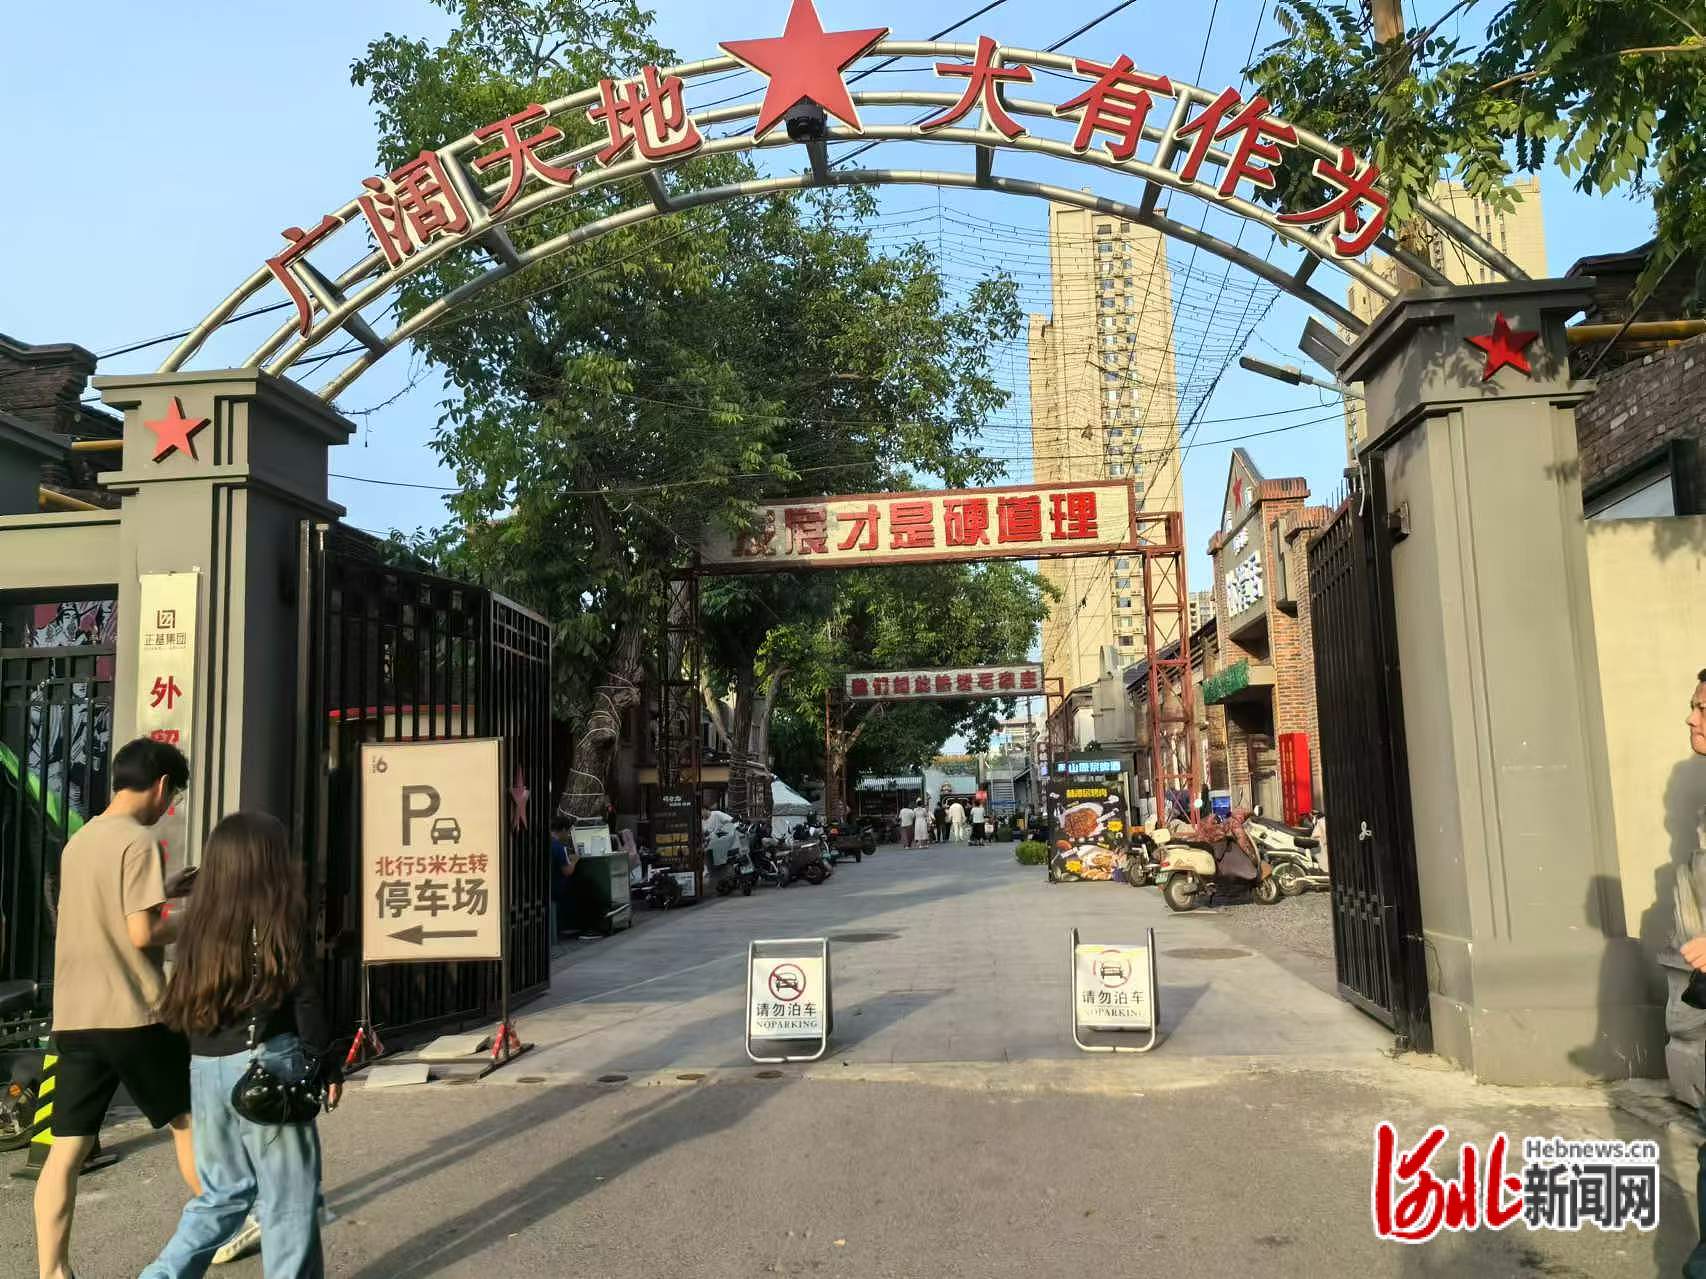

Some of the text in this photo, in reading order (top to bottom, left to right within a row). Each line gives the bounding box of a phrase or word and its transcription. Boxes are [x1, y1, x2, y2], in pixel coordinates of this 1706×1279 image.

[265, 34, 1389, 340] 广阔天地 大有作为
[402, 785, 441, 846] P
[375, 853, 489, 877] 北行5米左转
[375, 878, 489, 919] 停车场
[756, 1001, 817, 1017] 请勿泊车
[1082, 990, 1144, 1004] 请勿泊车
